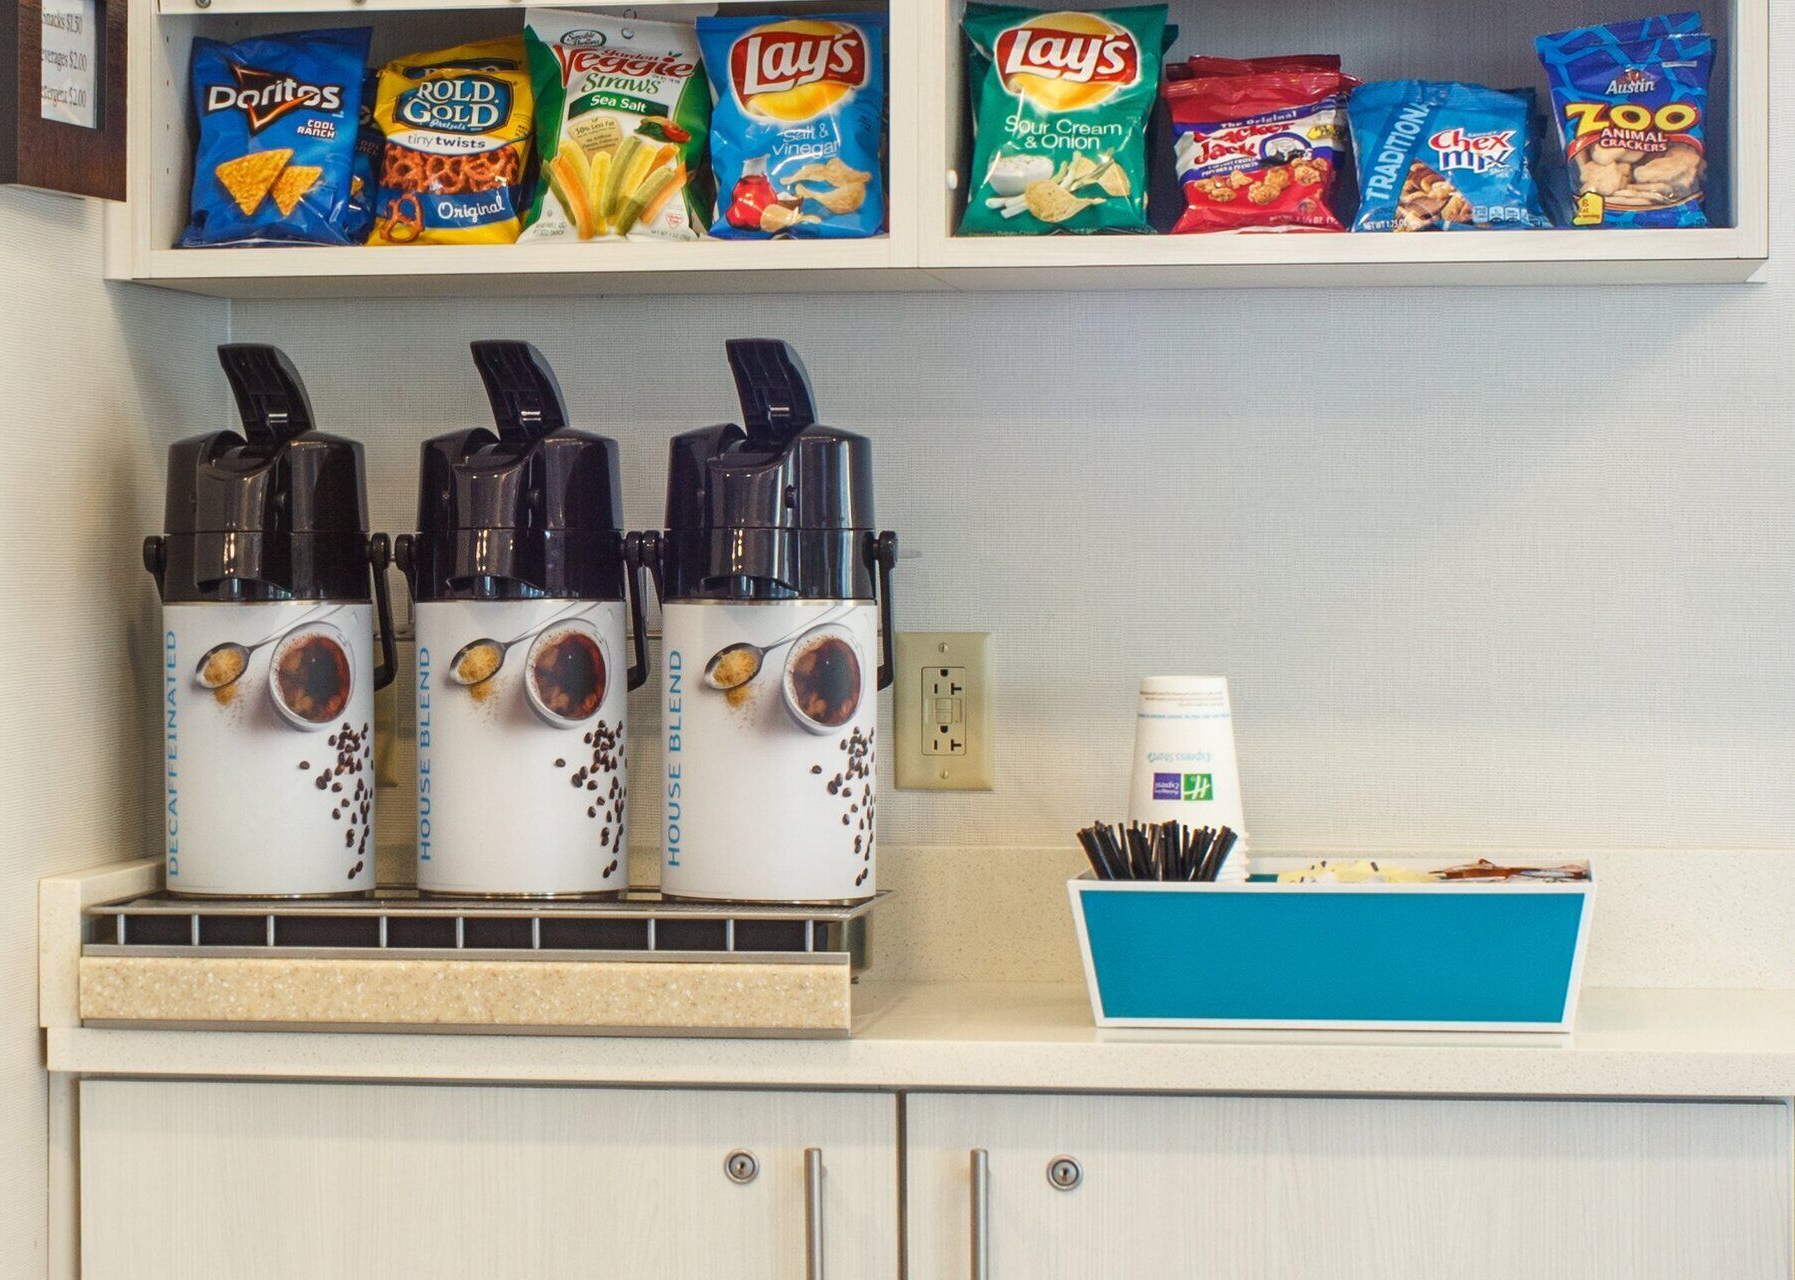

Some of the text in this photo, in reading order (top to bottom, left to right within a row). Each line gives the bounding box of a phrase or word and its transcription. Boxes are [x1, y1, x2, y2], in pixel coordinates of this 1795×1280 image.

[69, 50, 87, 73] $2.00
[552, 44, 695, 88] Veggie
[743, 32, 857, 96] Lay's
[1004, 27, 1132, 83] Lay's
[207, 76, 342, 114] Doritos
[416, 80, 497, 103] ROLD
[581, 72, 661, 95] Straws
[1605, 79, 1656, 95] Austin
[69, 86, 87, 108] $2.00
[590, 94, 648, 114] Sea Salt
[307, 119, 336, 131] COOL
[1004, 114, 1123, 137] Sour Cream
[1220, 111, 1298, 129] The Original
[1565, 103, 1698, 137] ZOO
[297, 126, 336, 140] RANCH
[407, 134, 487, 149] tiny twists
[782, 126, 830, 144] Salt &
[1024, 133, 1101, 151] & Onion
[1429, 128, 1517, 152] Chex
[1600, 128, 1668, 142] ANIMAL
[1193, 141, 1258, 165] Jack
[1365, 90, 1440, 201] TRADITIONA
[1599, 138, 1668, 153] CRACKERS
[437, 191, 506, 223] Original
[166, 630, 179, 878] DECAFFEINATED
[419, 646, 432, 861] HOUSE BLEND
[667, 650, 683, 866] HOUSE BLEND
